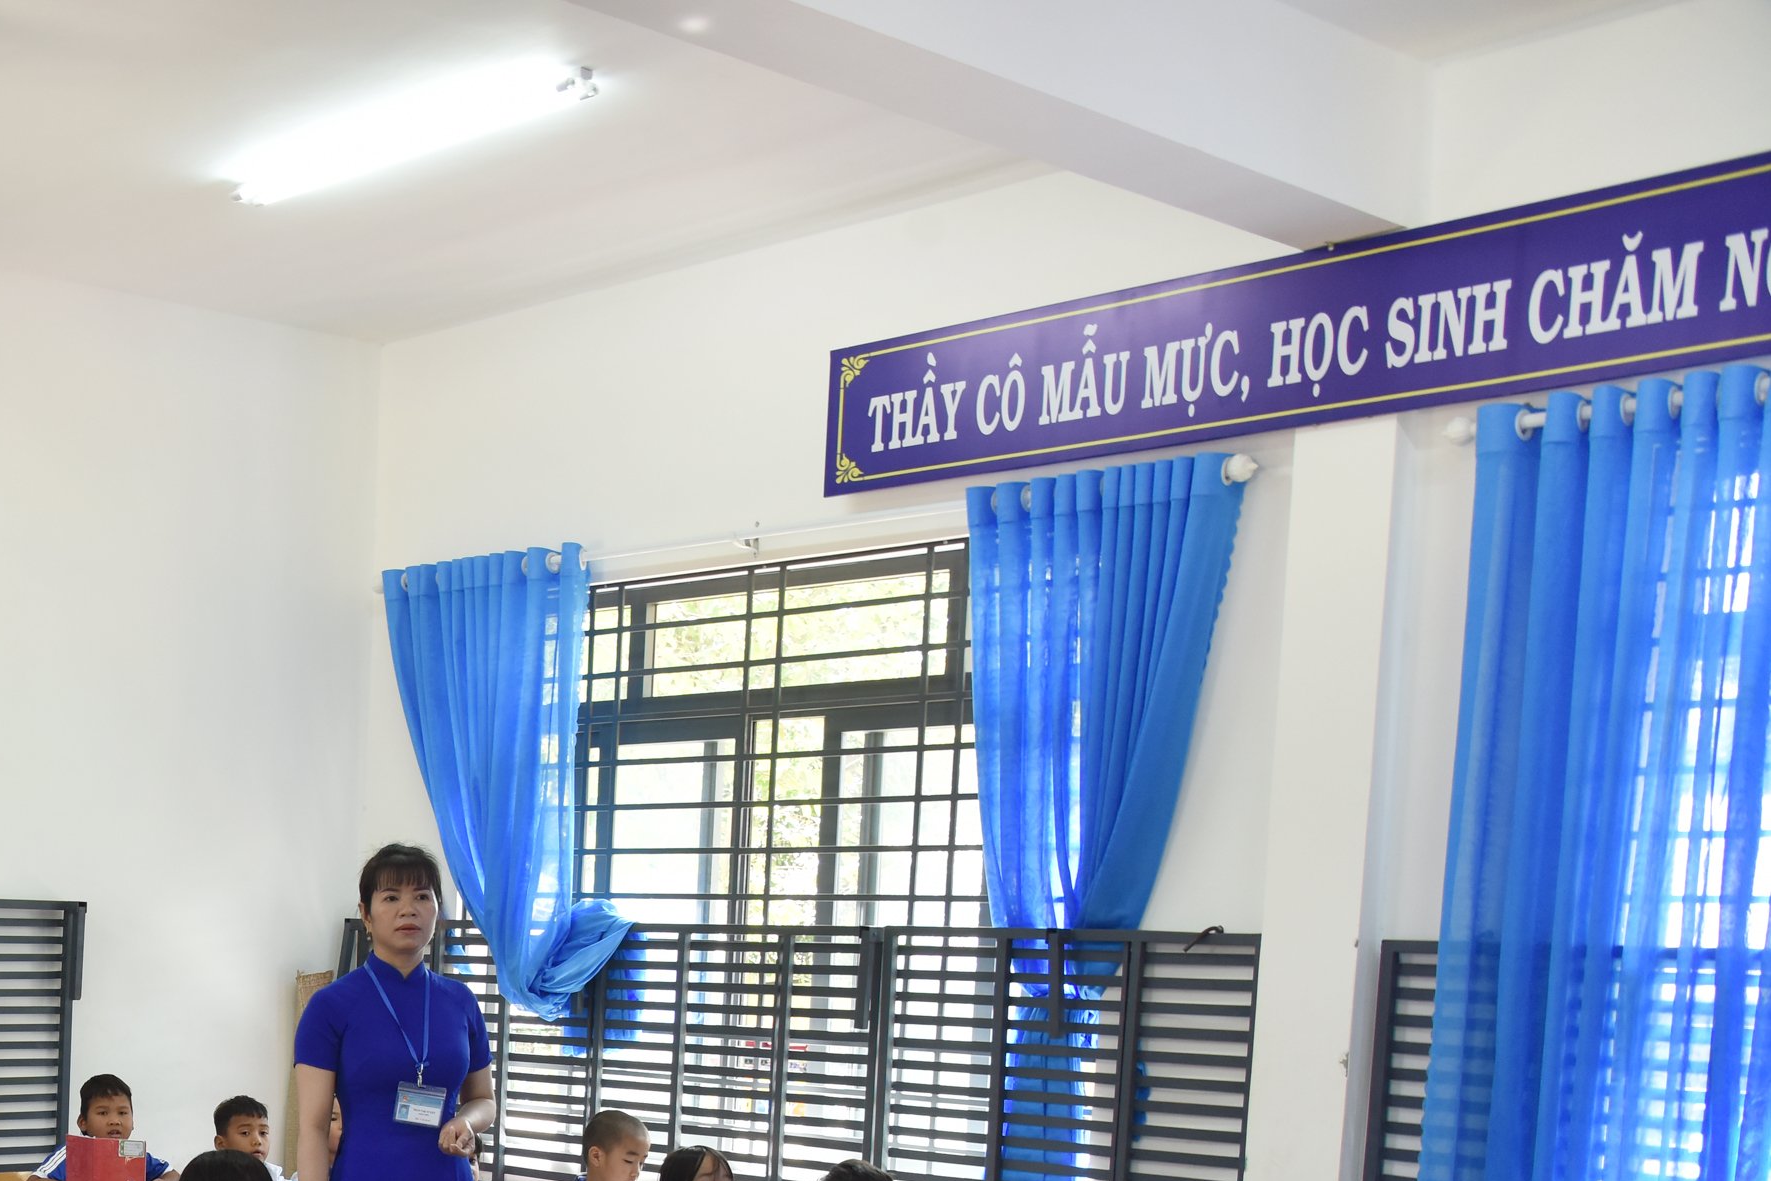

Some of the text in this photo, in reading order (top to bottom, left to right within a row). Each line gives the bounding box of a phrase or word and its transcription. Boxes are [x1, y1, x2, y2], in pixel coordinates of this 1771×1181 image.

[868, 227, 1771, 452] THẦY CÔ MẪU MỰC, HỌC SINH CHĂM N
